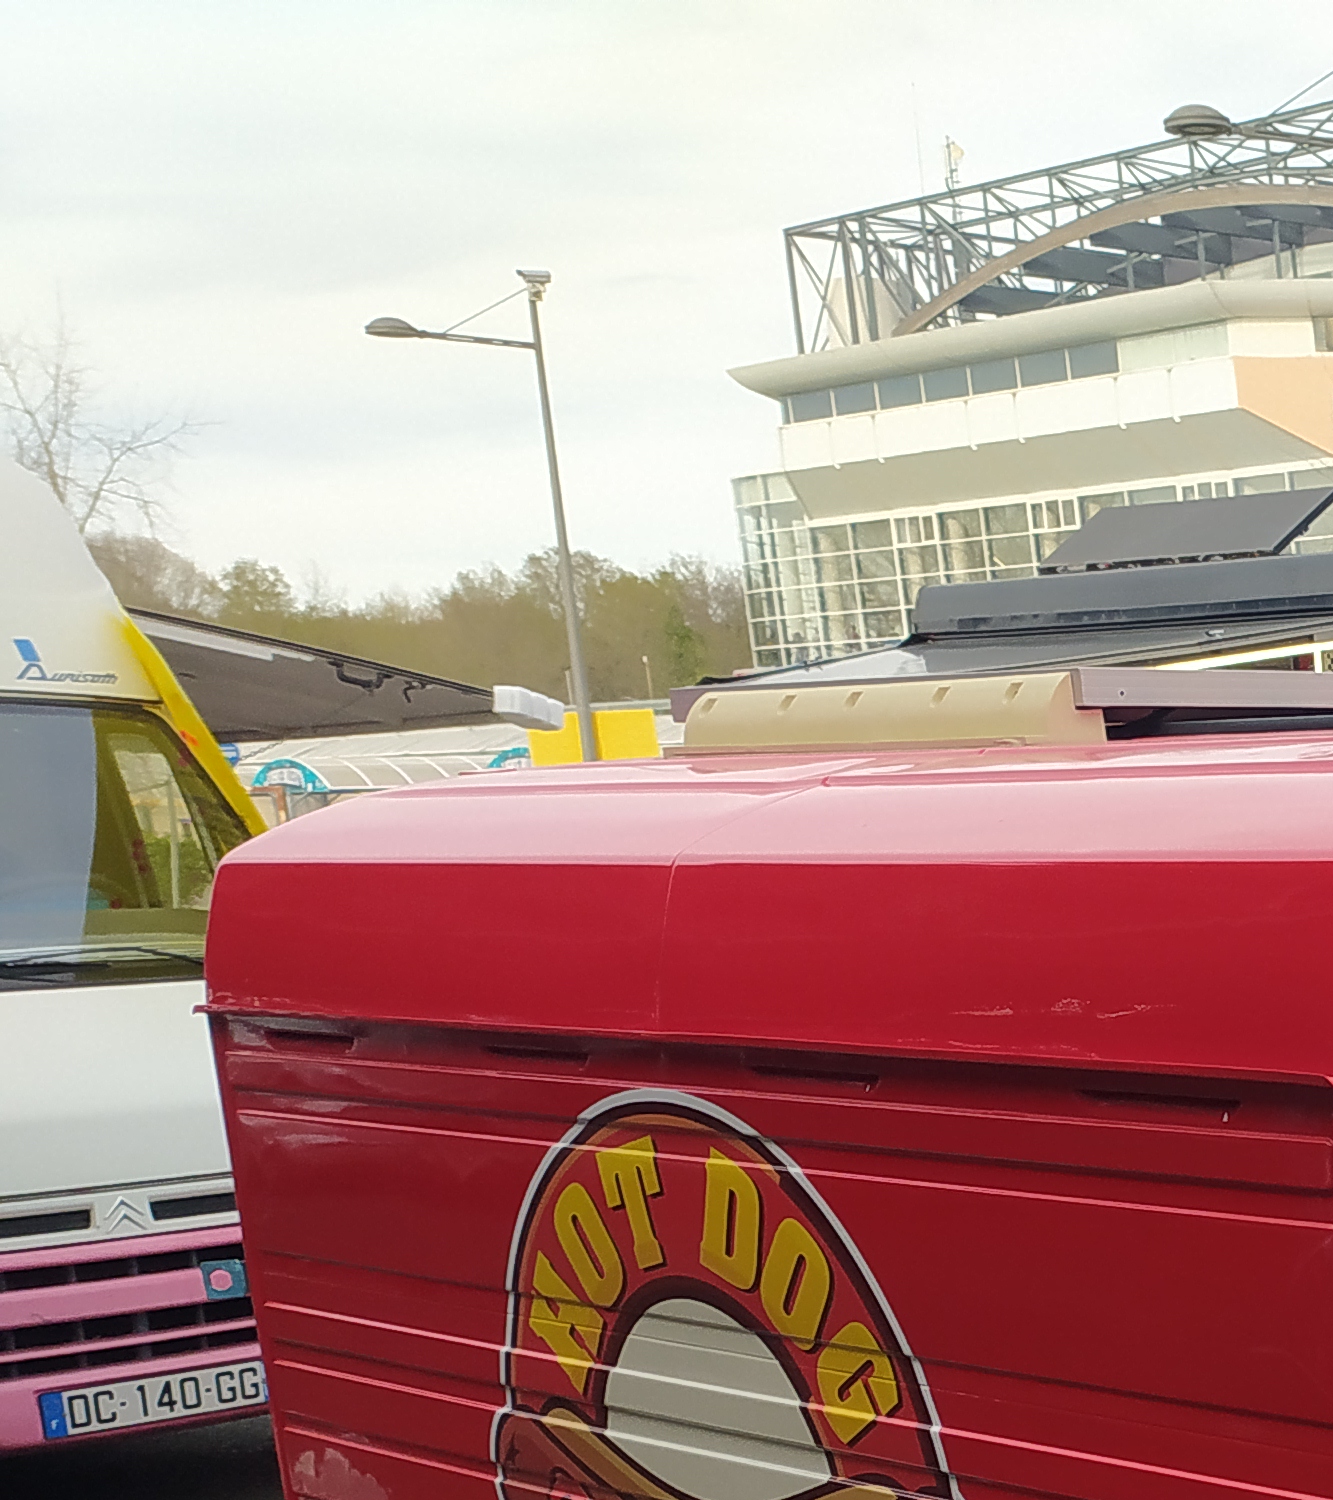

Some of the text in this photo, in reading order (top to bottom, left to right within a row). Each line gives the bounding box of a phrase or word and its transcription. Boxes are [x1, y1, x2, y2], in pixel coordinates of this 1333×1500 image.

[528, 1134, 901, 1447] HOT DOG
[67, 1367, 260, 1429] DC-140-GG
